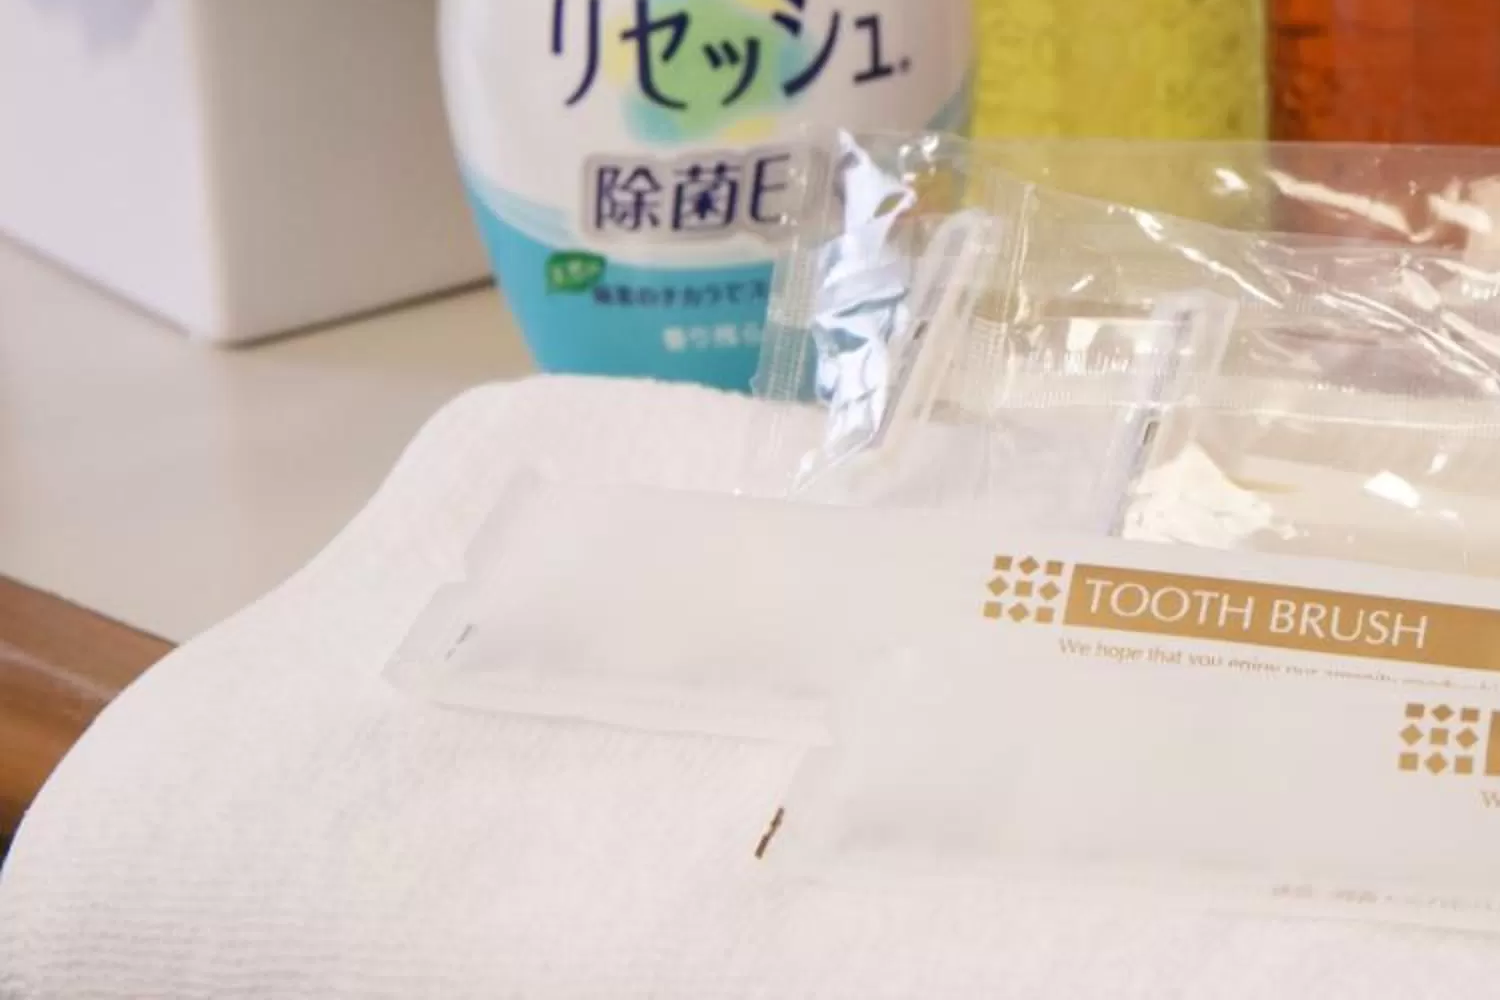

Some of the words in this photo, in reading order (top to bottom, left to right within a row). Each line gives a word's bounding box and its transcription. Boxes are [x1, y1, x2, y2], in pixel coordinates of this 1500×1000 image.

[594, 153, 793, 231] 除菌E
[1085, 578, 1255, 632] TOOTH
[1269, 599, 1429, 649] BRUSH
[1058, 637, 1091, 657] We
[1095, 640, 1145, 664] hope
[1147, 645, 1183, 666] that
